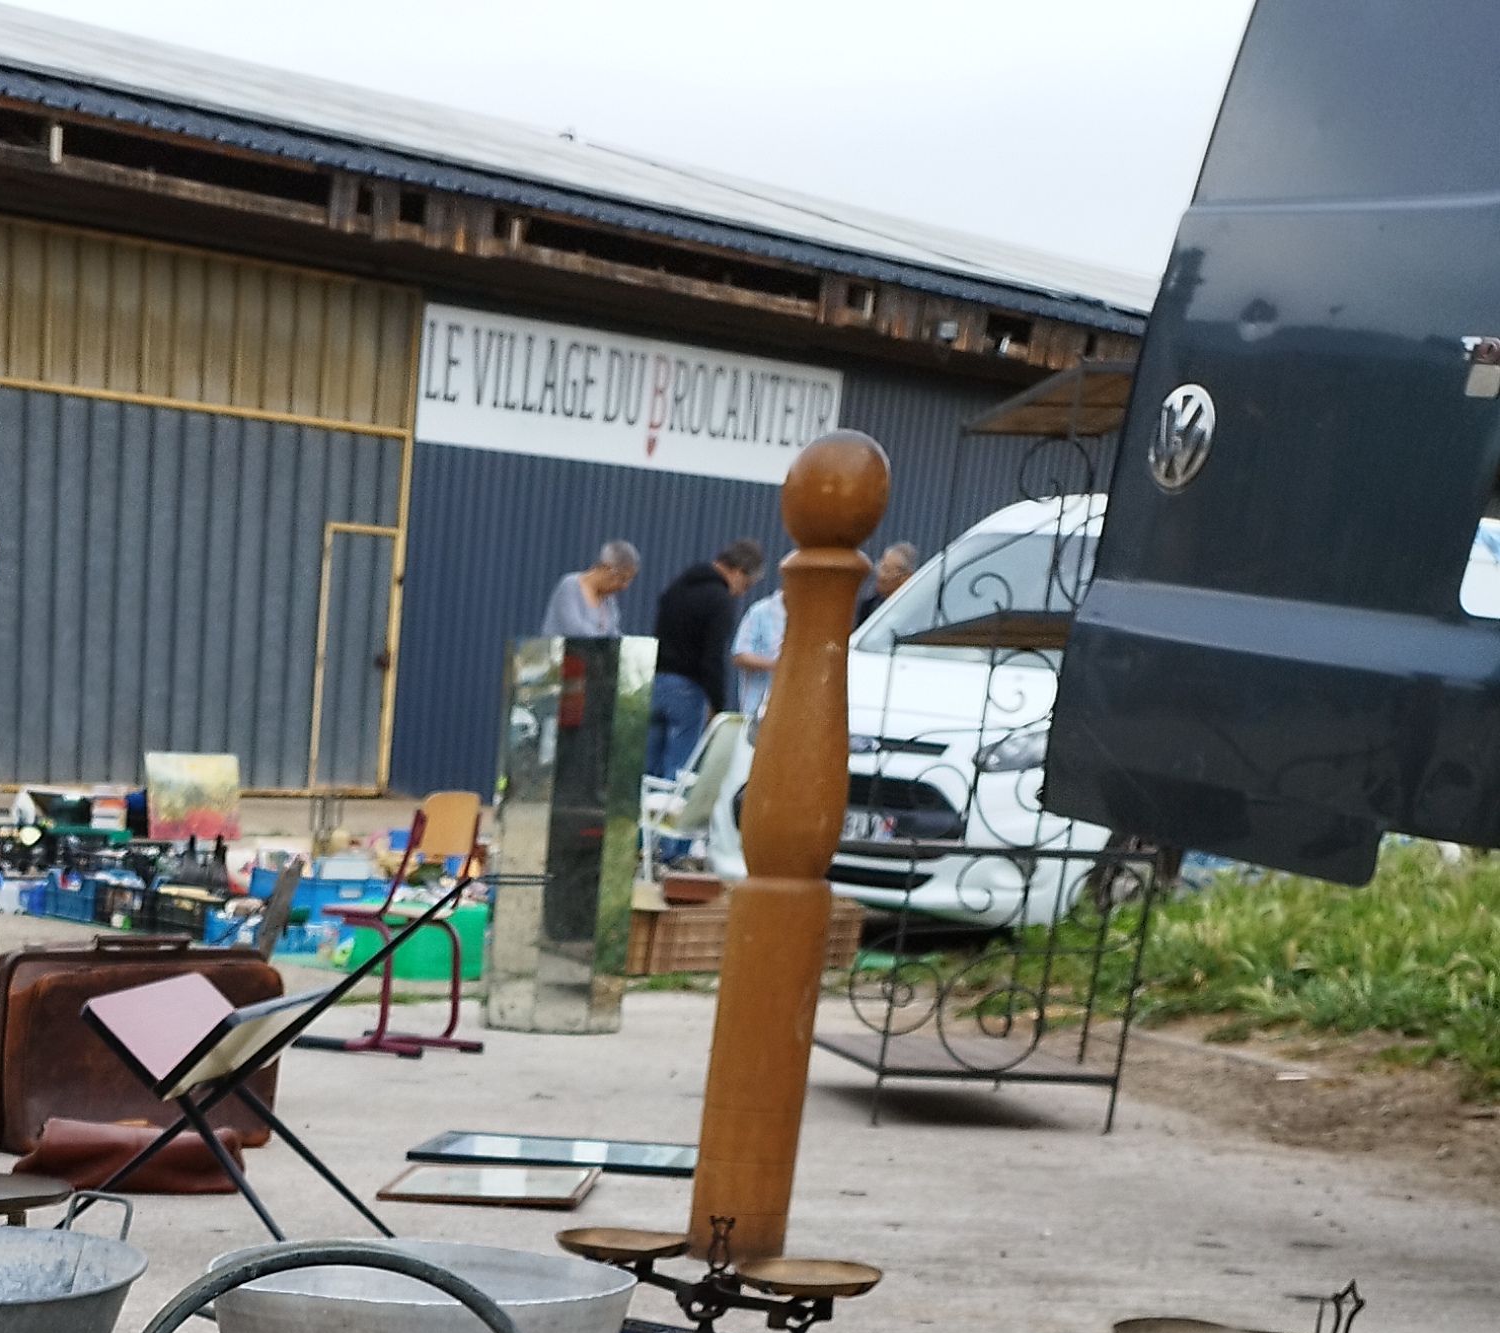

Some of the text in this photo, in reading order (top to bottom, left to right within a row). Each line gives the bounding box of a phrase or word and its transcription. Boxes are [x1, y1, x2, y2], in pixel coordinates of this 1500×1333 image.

[423, 319, 834, 447] LE VILLAGE DU BROCANTEUR
